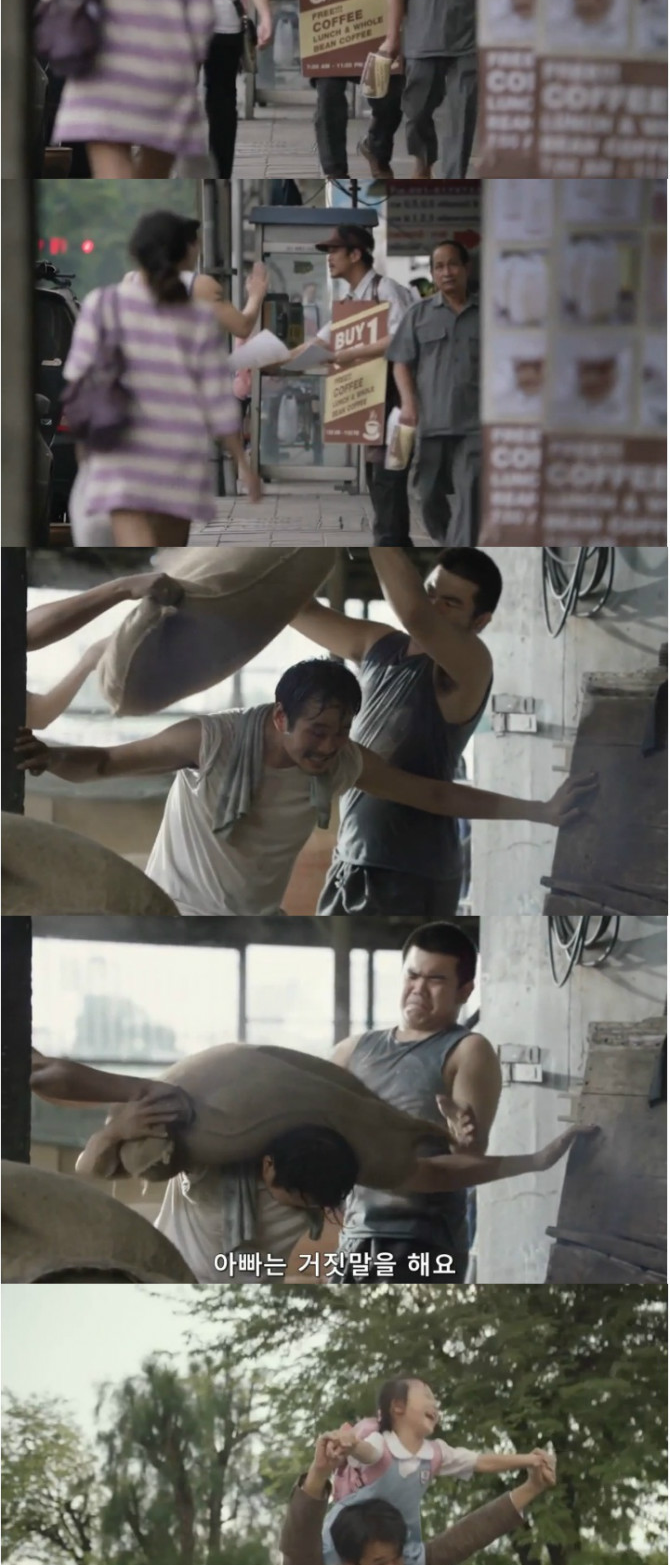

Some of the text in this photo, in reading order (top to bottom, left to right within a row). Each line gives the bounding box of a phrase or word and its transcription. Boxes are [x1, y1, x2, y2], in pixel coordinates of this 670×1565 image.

[312, 8, 363, 33] COFFEE
[312, 28, 342, 43] LUNCH
[353, 15, 384, 31] WHOLE
[313, 28, 372, 53] BEAN COFFEE
[334, 316, 379, 350] BUY 1
[333, 377, 364, 399] COFFEE
